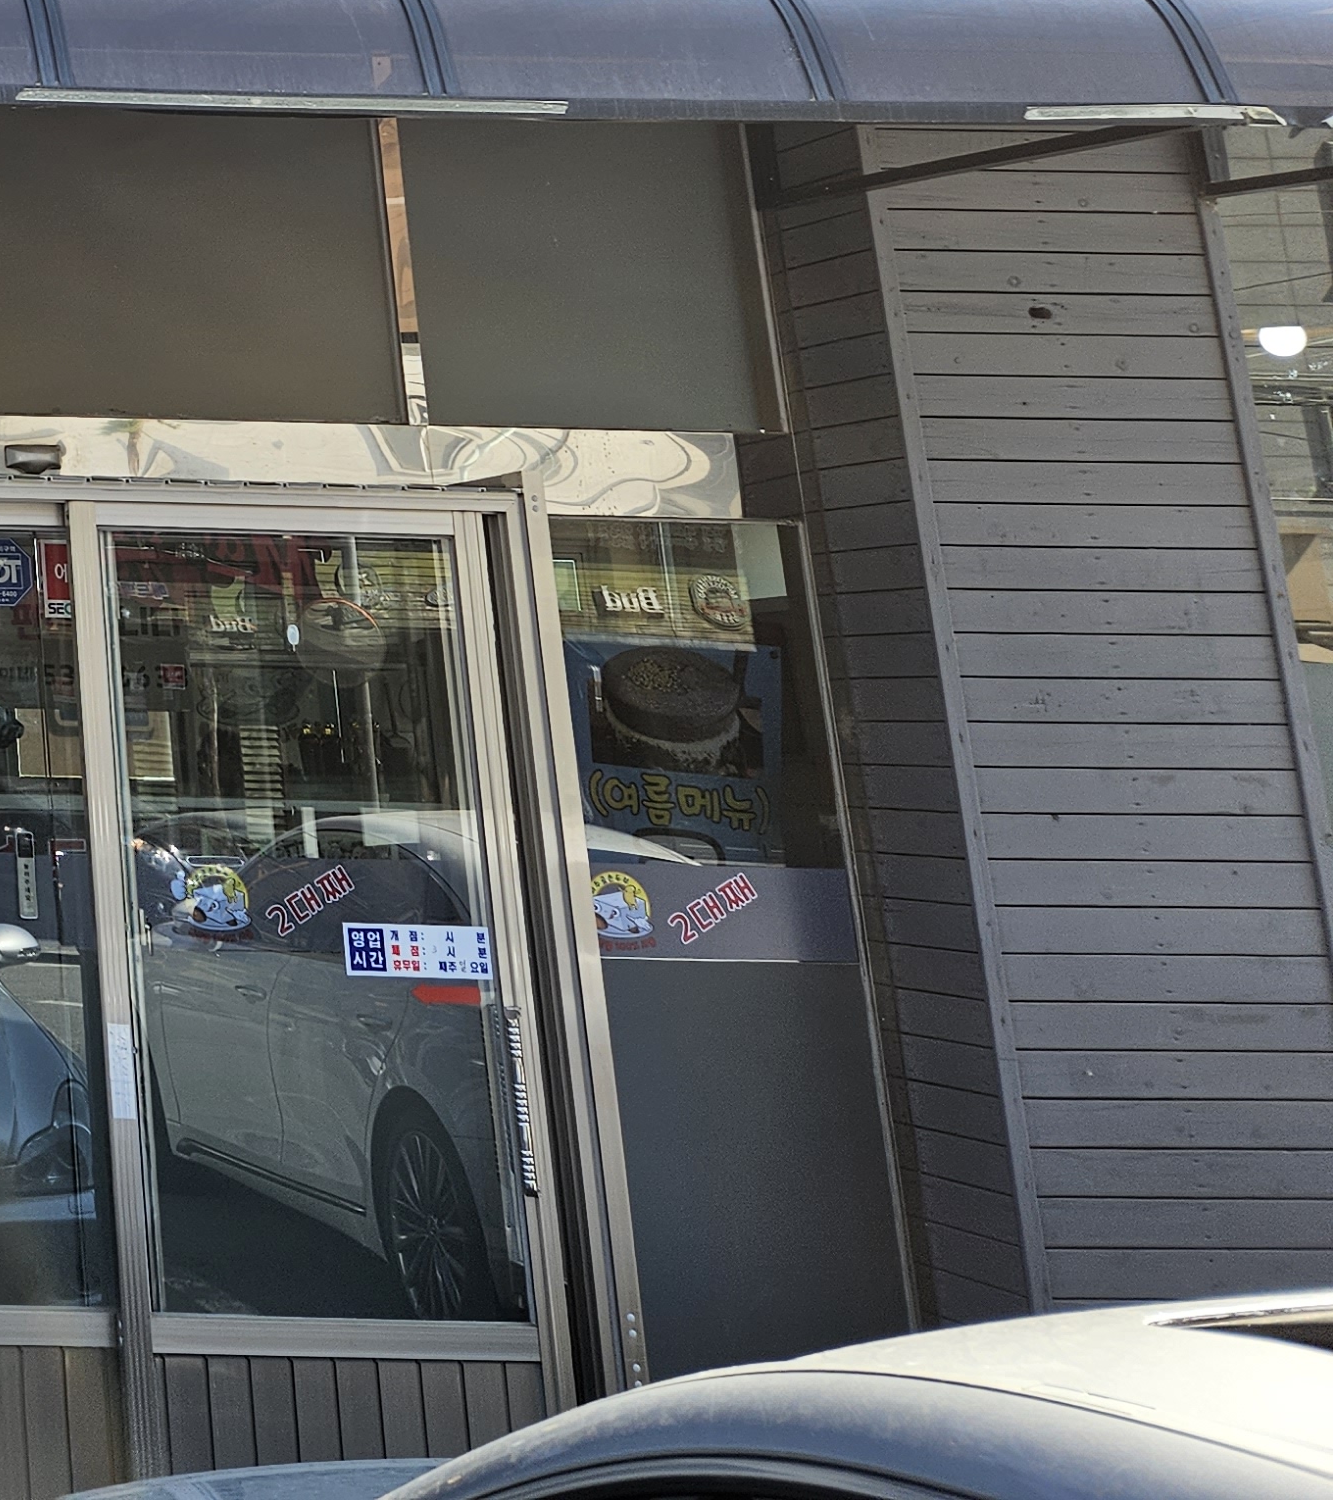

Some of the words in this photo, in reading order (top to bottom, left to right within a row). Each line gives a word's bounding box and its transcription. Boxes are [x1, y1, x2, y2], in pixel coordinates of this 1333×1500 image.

[588, 768, 770, 836] (여름메뉴)
[351, 931, 381, 948] 영업
[445, 931, 454, 943] 시
[353, 950, 384, 968] 시간
[447, 946, 455, 957] 시
